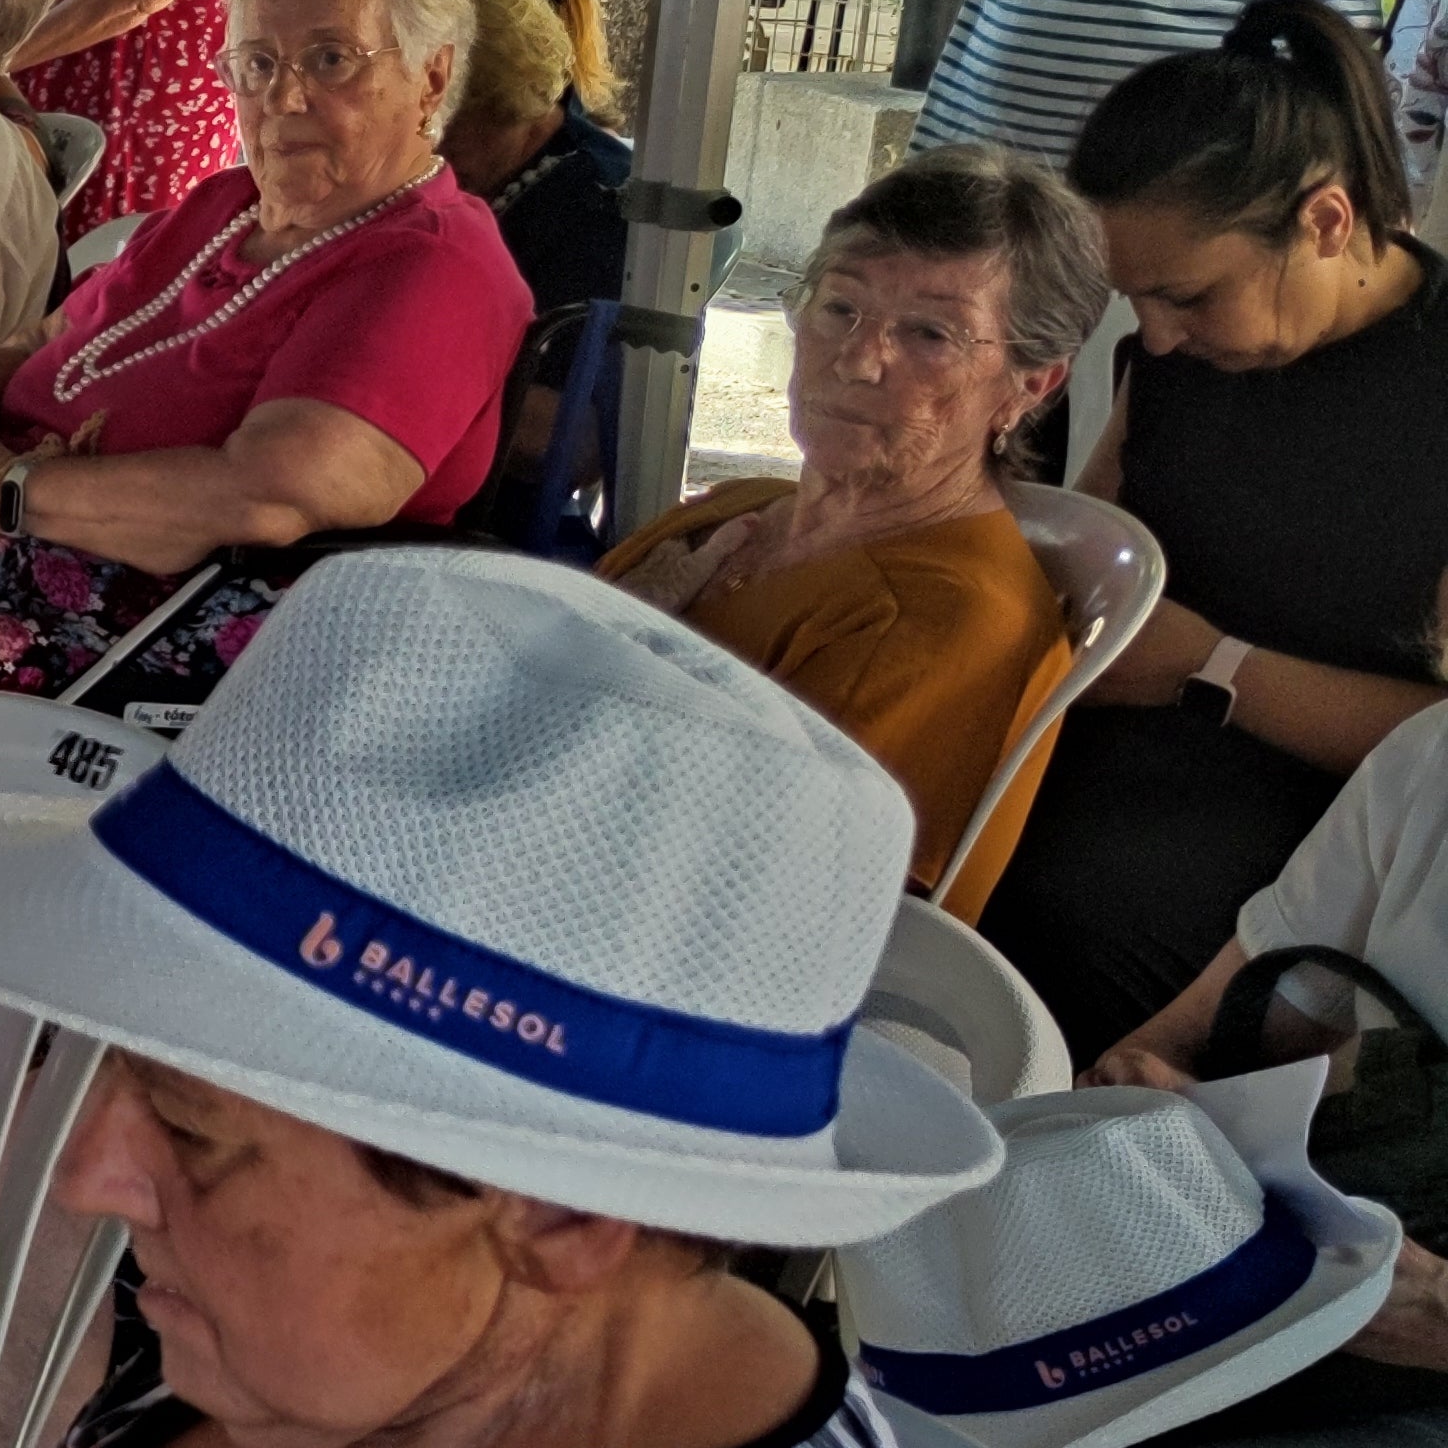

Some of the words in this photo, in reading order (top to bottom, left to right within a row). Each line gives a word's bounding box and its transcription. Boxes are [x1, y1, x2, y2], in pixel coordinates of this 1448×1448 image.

[48, 730, 124, 791] 485
[359, 940, 567, 1055] BALLESOL
[1069, 1310, 1199, 1368] BALLESOL
